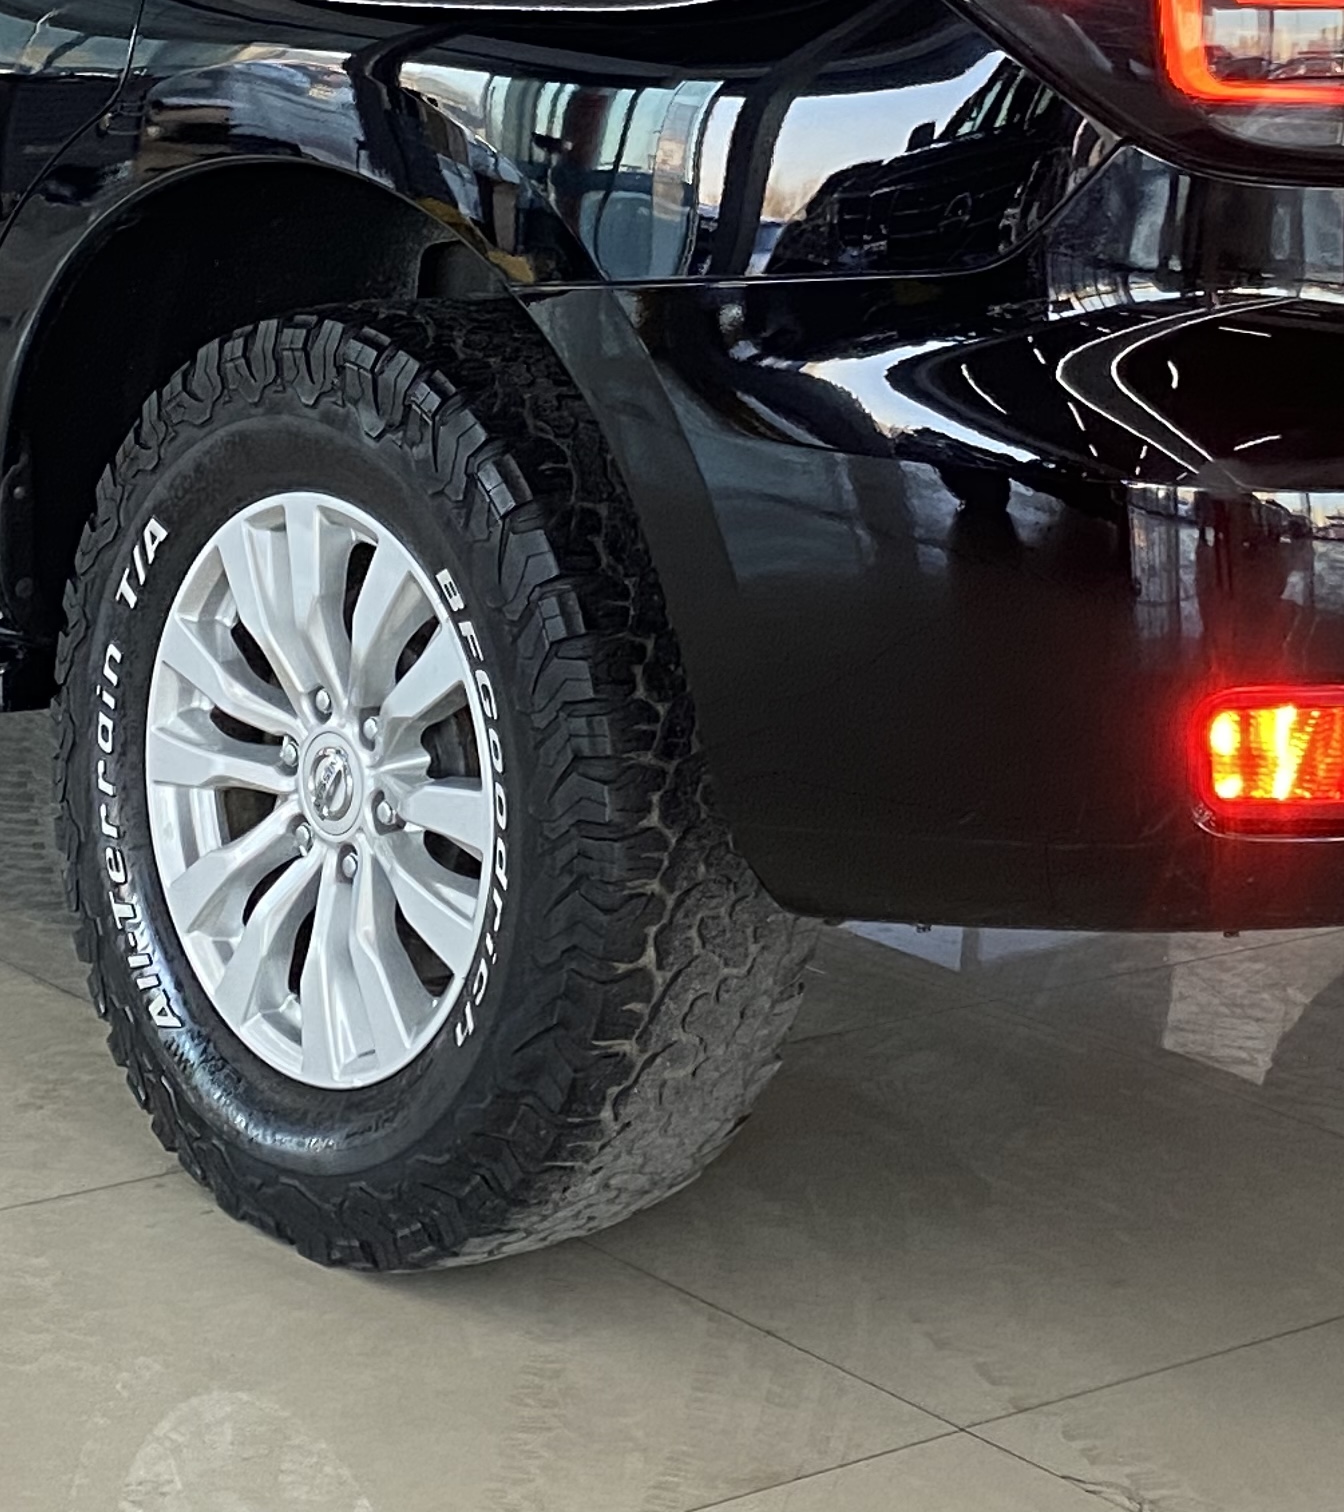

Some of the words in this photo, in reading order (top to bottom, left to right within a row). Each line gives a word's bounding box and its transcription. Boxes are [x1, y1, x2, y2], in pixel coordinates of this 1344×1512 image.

[115, 516, 169, 609] T/A
[96, 642, 183, 1028] All-Terrain
[435, 568, 509, 1048] BFGoodrich
